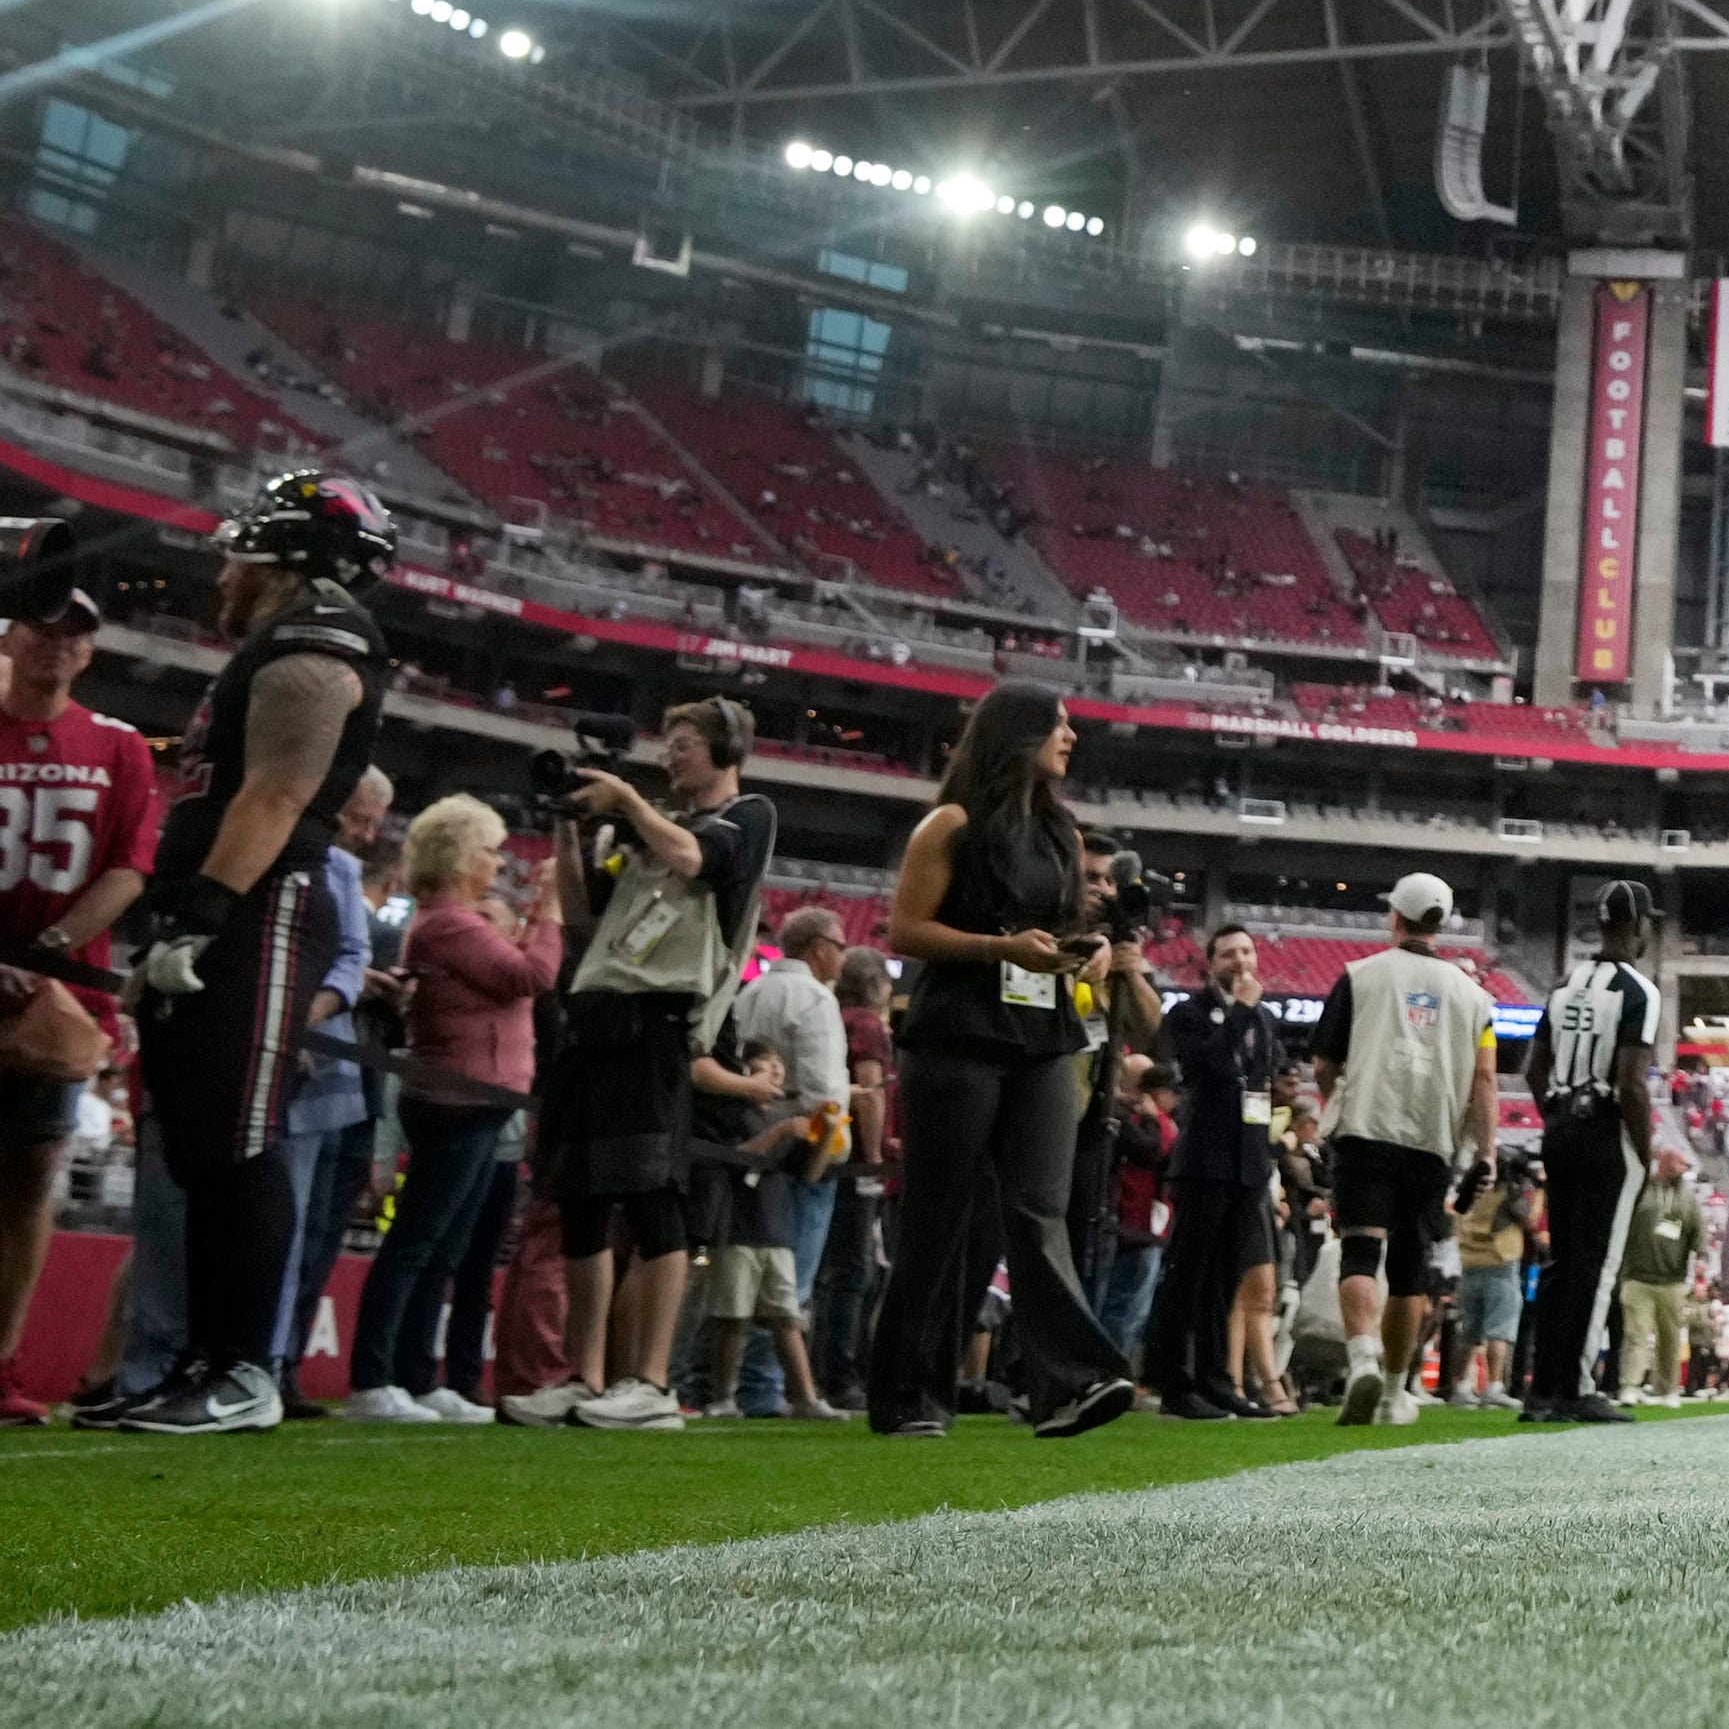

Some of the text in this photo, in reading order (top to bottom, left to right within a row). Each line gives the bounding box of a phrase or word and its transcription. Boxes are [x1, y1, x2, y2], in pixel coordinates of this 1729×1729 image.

[1600, 320, 1632, 549] FOOTBALL
[1593, 556, 1619, 670] CLUB
[0, 763, 111, 787] IZONA
